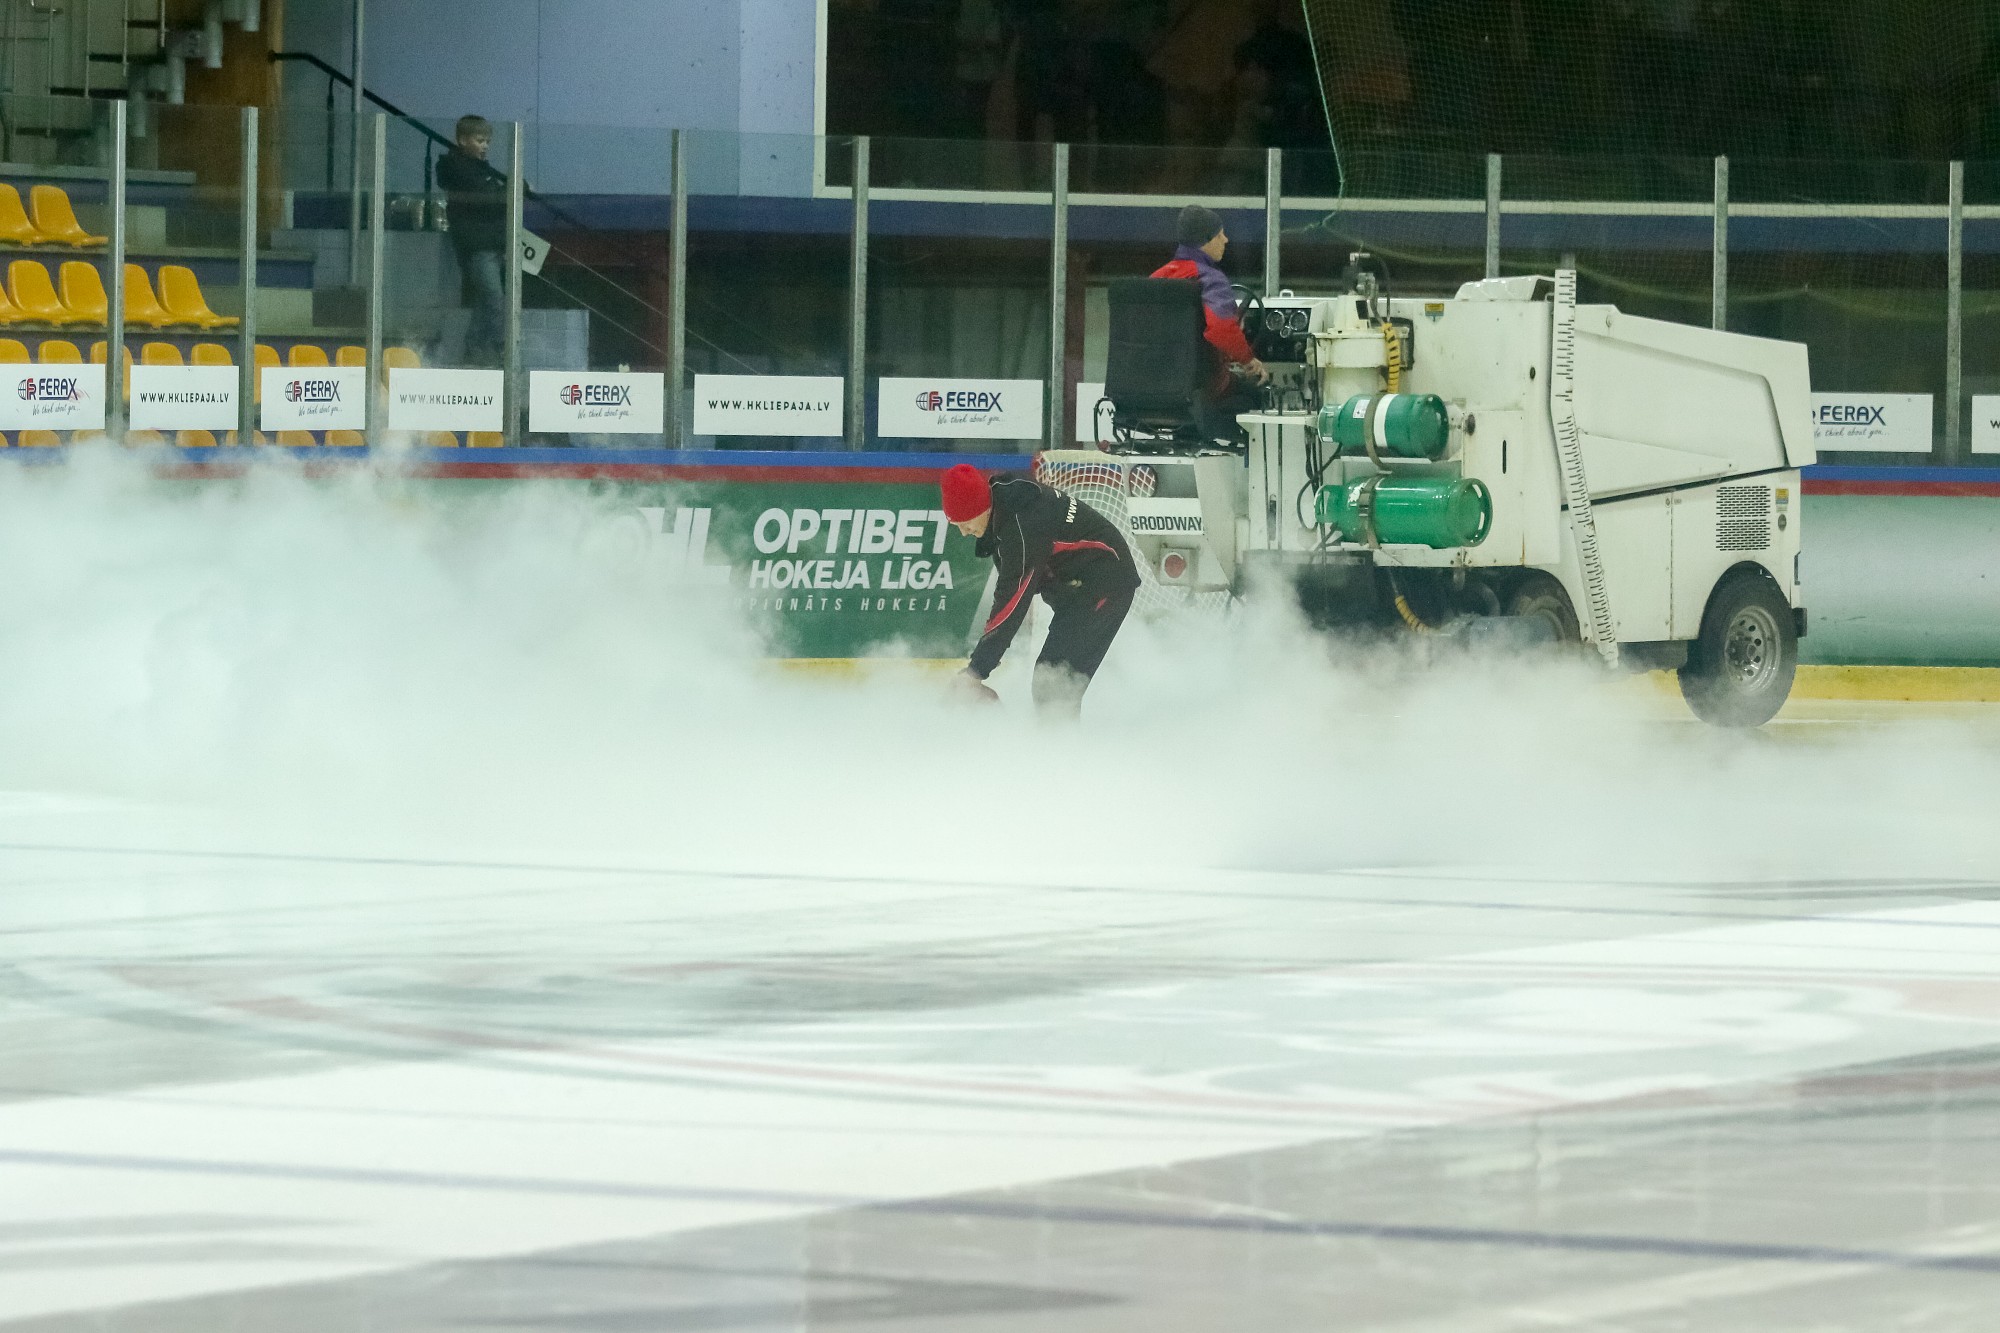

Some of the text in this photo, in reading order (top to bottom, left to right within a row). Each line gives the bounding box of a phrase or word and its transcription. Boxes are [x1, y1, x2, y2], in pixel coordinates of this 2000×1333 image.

[39, 378, 78, 401] FERAX
[140, 392, 230, 403] WWW.HKLIEPAJA.LV
[305, 380, 341, 402] FERAX
[399, 394, 494, 406] WWW.HKLIEPAJA.LV
[585, 385, 631, 406] FERAX
[708, 399, 831, 412] WWW.HKLIEPAJA.LV
[946, 391, 1003, 412] FERAX
[1820, 405, 1886, 426] FERAX
[753, 507, 950, 555] OPTIBET
[1130, 515, 1202, 531] BRODDWAY
[749, 556, 953, 590] HOKEJA LĪGA
[860, 594, 947, 611] HOKEJĀ
